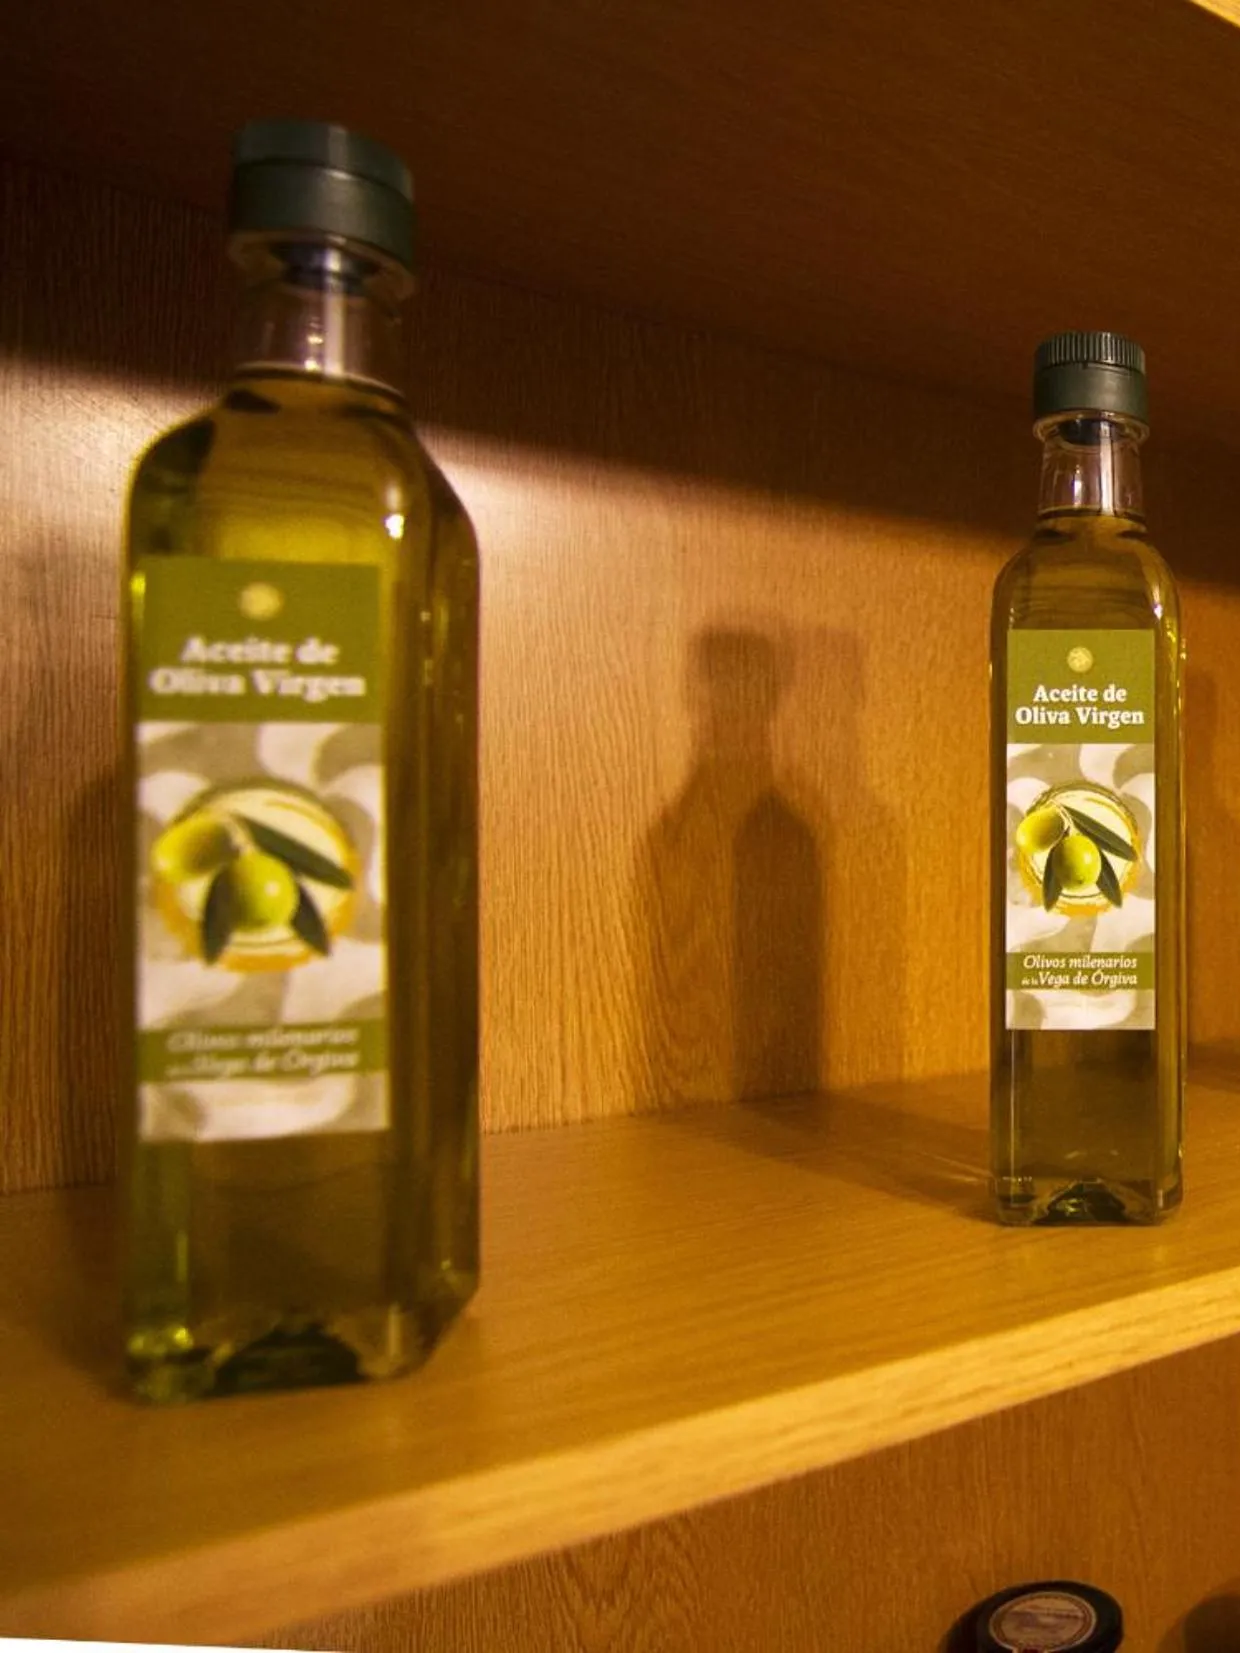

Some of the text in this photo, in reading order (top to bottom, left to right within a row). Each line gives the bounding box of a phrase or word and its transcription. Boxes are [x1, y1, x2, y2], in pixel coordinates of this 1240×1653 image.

[181, 637, 339, 665] Aceite de
[150, 668, 365, 702] Oliva Virgen
[1033, 683, 1128, 703] Aceite de
[1015, 706, 1145, 729] Oliva Virgen
[1023, 954, 1137, 969] Olivos milenarios
[1039, 971, 1069, 988] Vega
[1072, 970, 1089, 985] de
